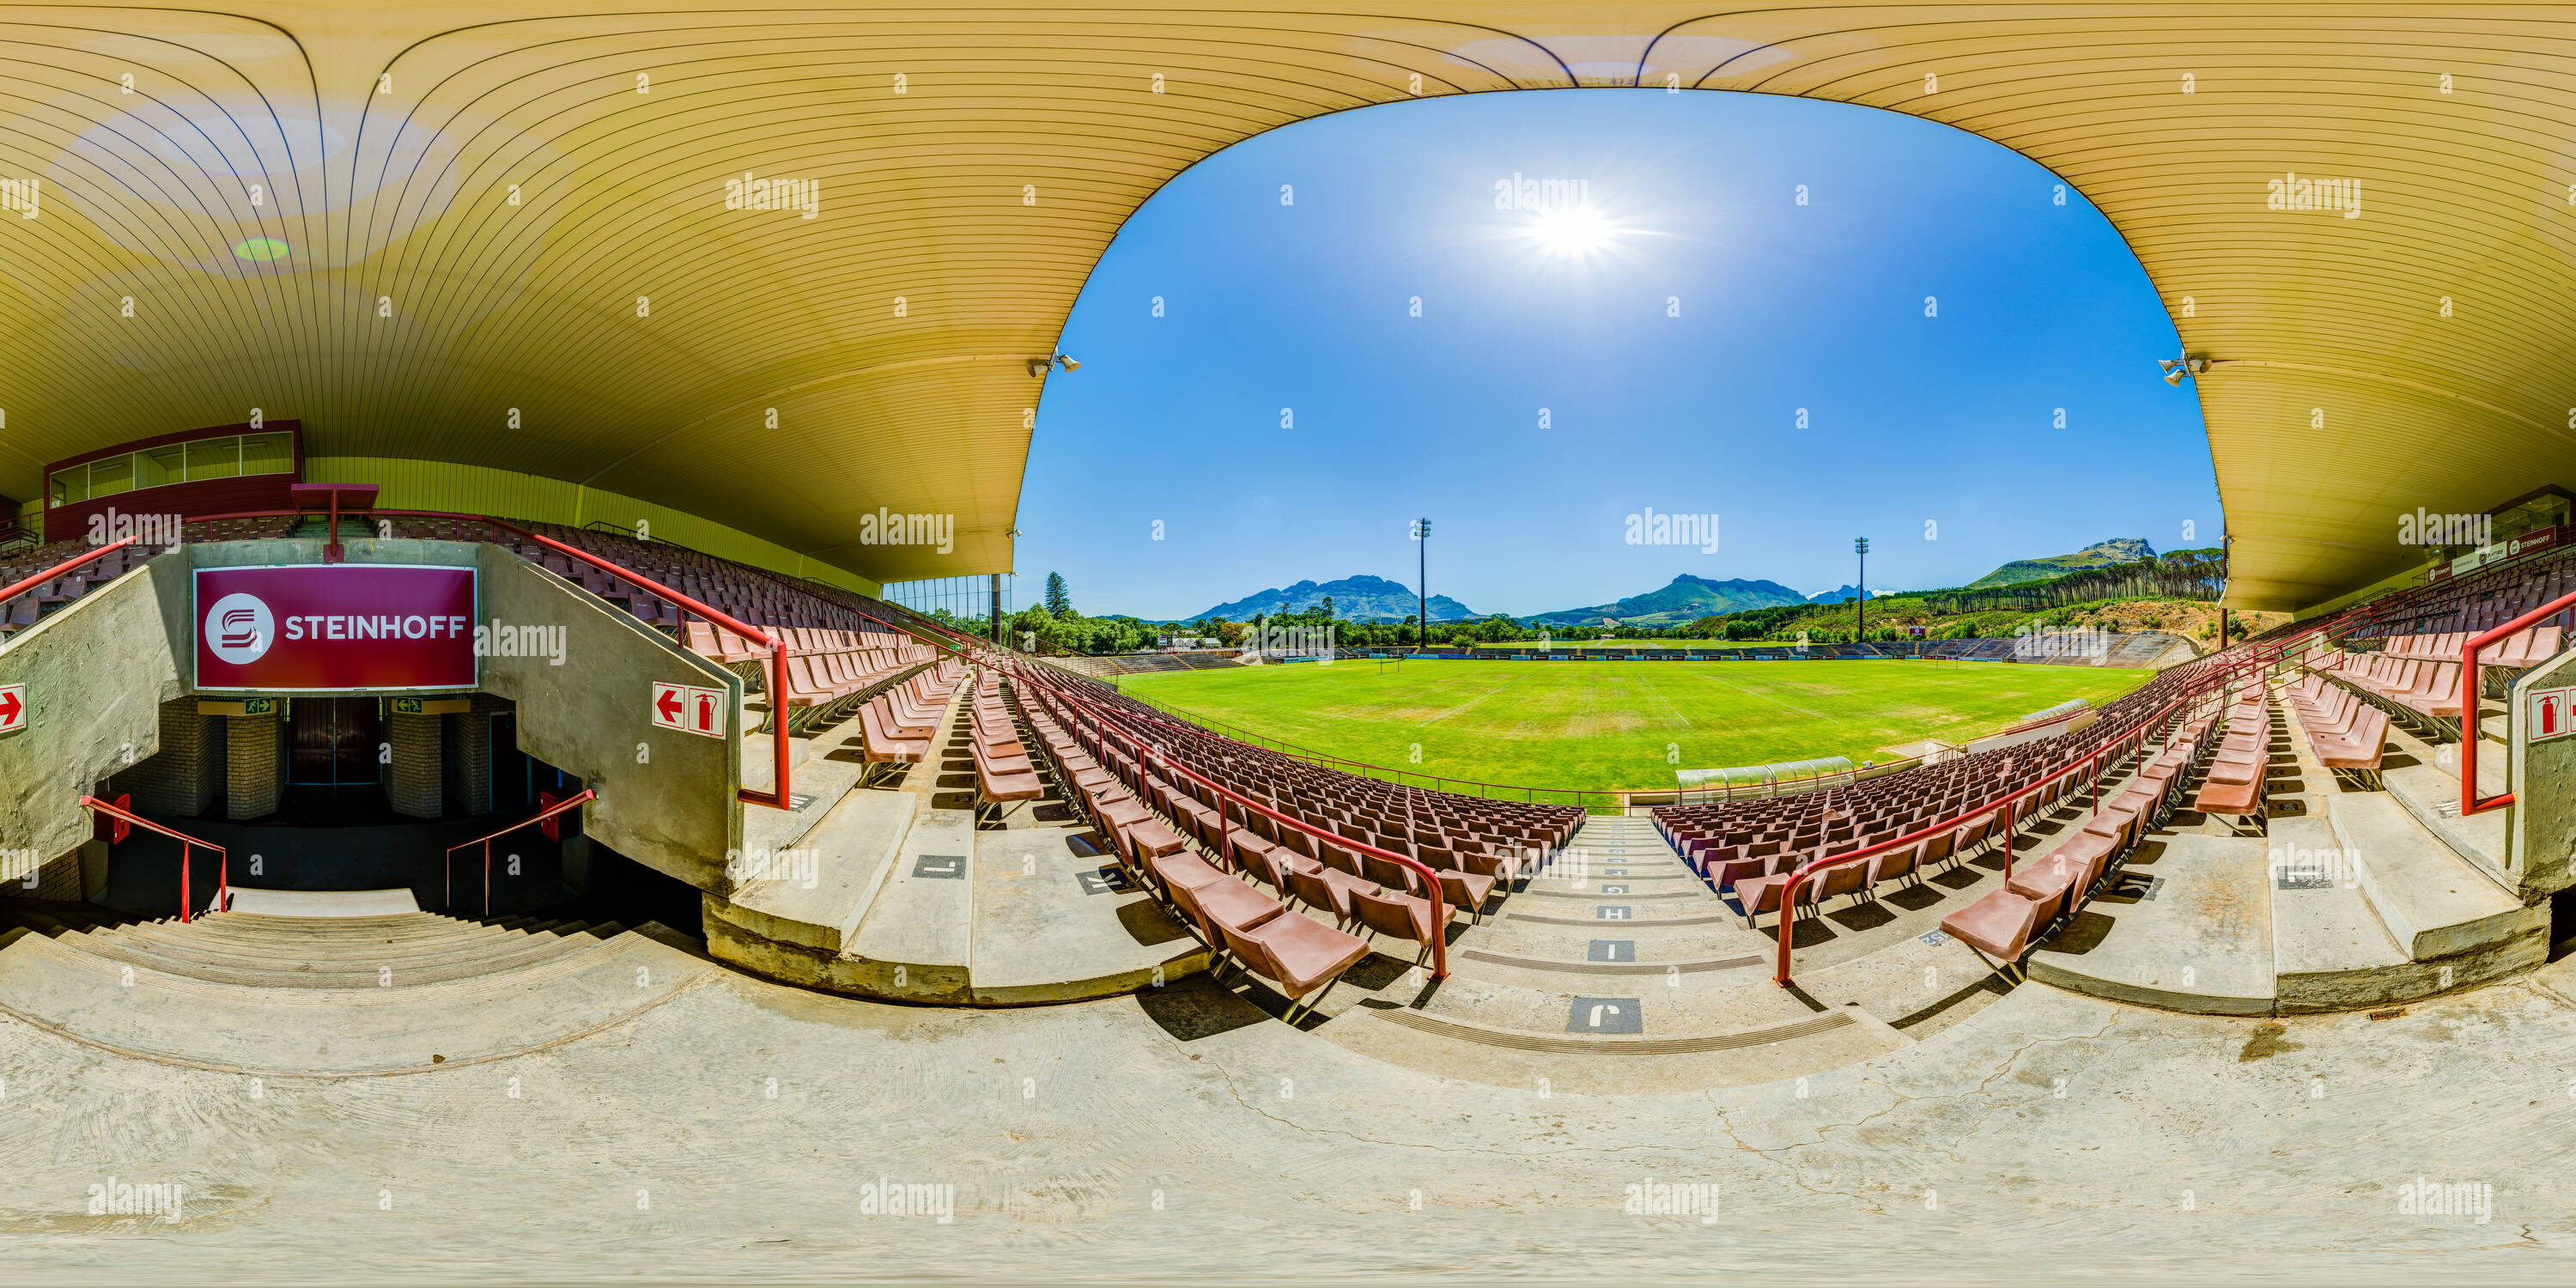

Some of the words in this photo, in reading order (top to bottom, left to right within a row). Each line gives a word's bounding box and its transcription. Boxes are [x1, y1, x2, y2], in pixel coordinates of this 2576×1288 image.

[2520, 535, 2550, 549] STEINHOFF
[285, 615, 466, 640] STEINHOFF
[1086, 872, 1122, 889] K
[1605, 908, 1623, 920] H
[1589, 1005, 1620, 1027] J
